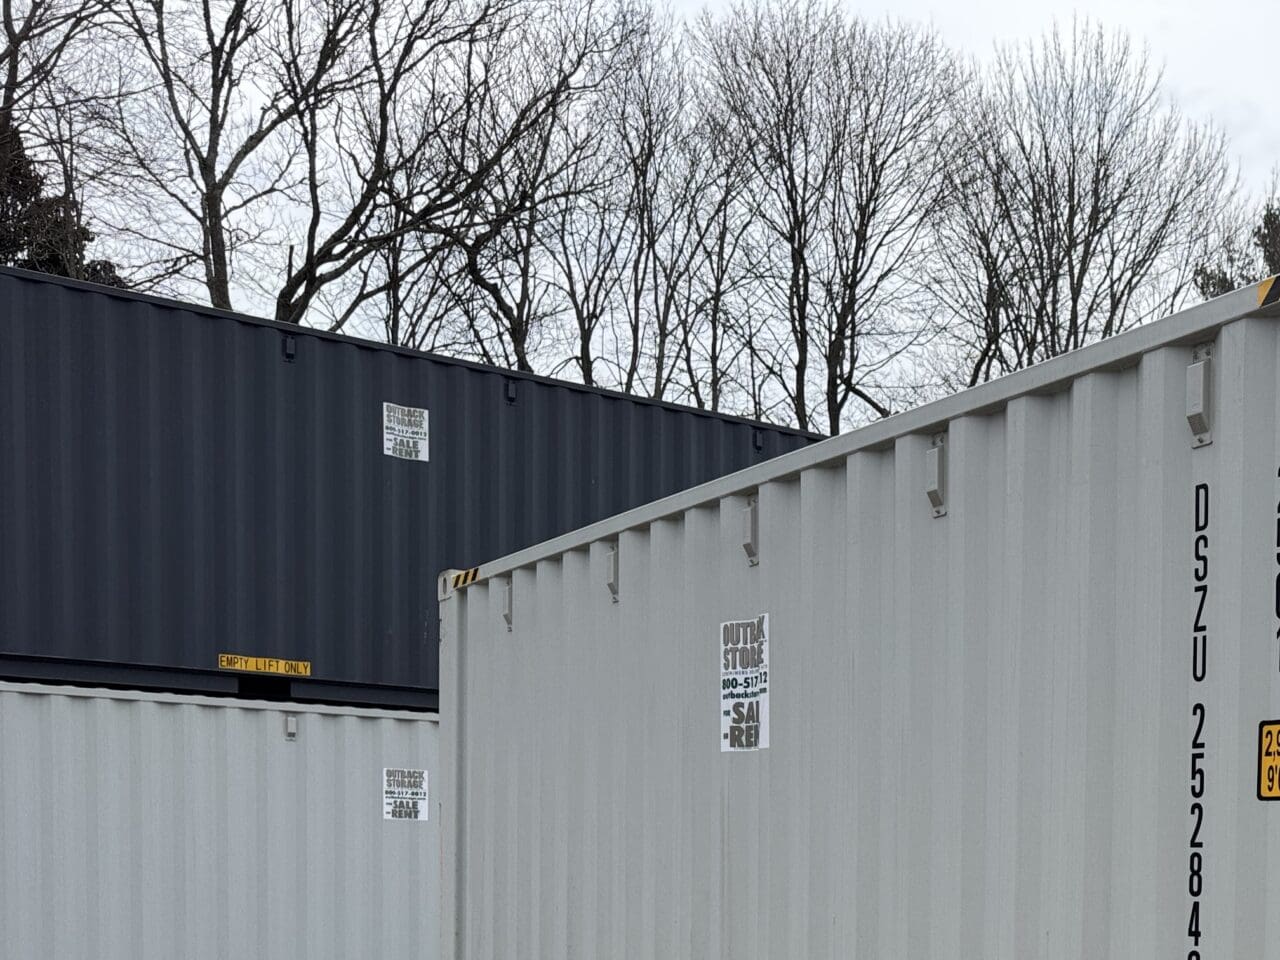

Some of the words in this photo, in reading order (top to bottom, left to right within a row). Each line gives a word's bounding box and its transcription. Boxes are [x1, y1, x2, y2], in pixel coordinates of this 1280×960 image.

[393, 437, 419, 450] SALE
[392, 446, 420, 459] RENT
[1192, 482, 1209, 682] DSZU
[220, 655, 249, 669] EMPTY
[255, 658, 280, 671] LIFT
[284, 661, 309, 674] ONLY
[732, 700, 760, 725] SAL
[729, 724, 760, 748] REN
[386, 769, 424, 780] OUTBACK
[386, 779, 424, 790] STORAGE
[393, 800, 419, 810] SALE
[391, 809, 420, 820] RENT
